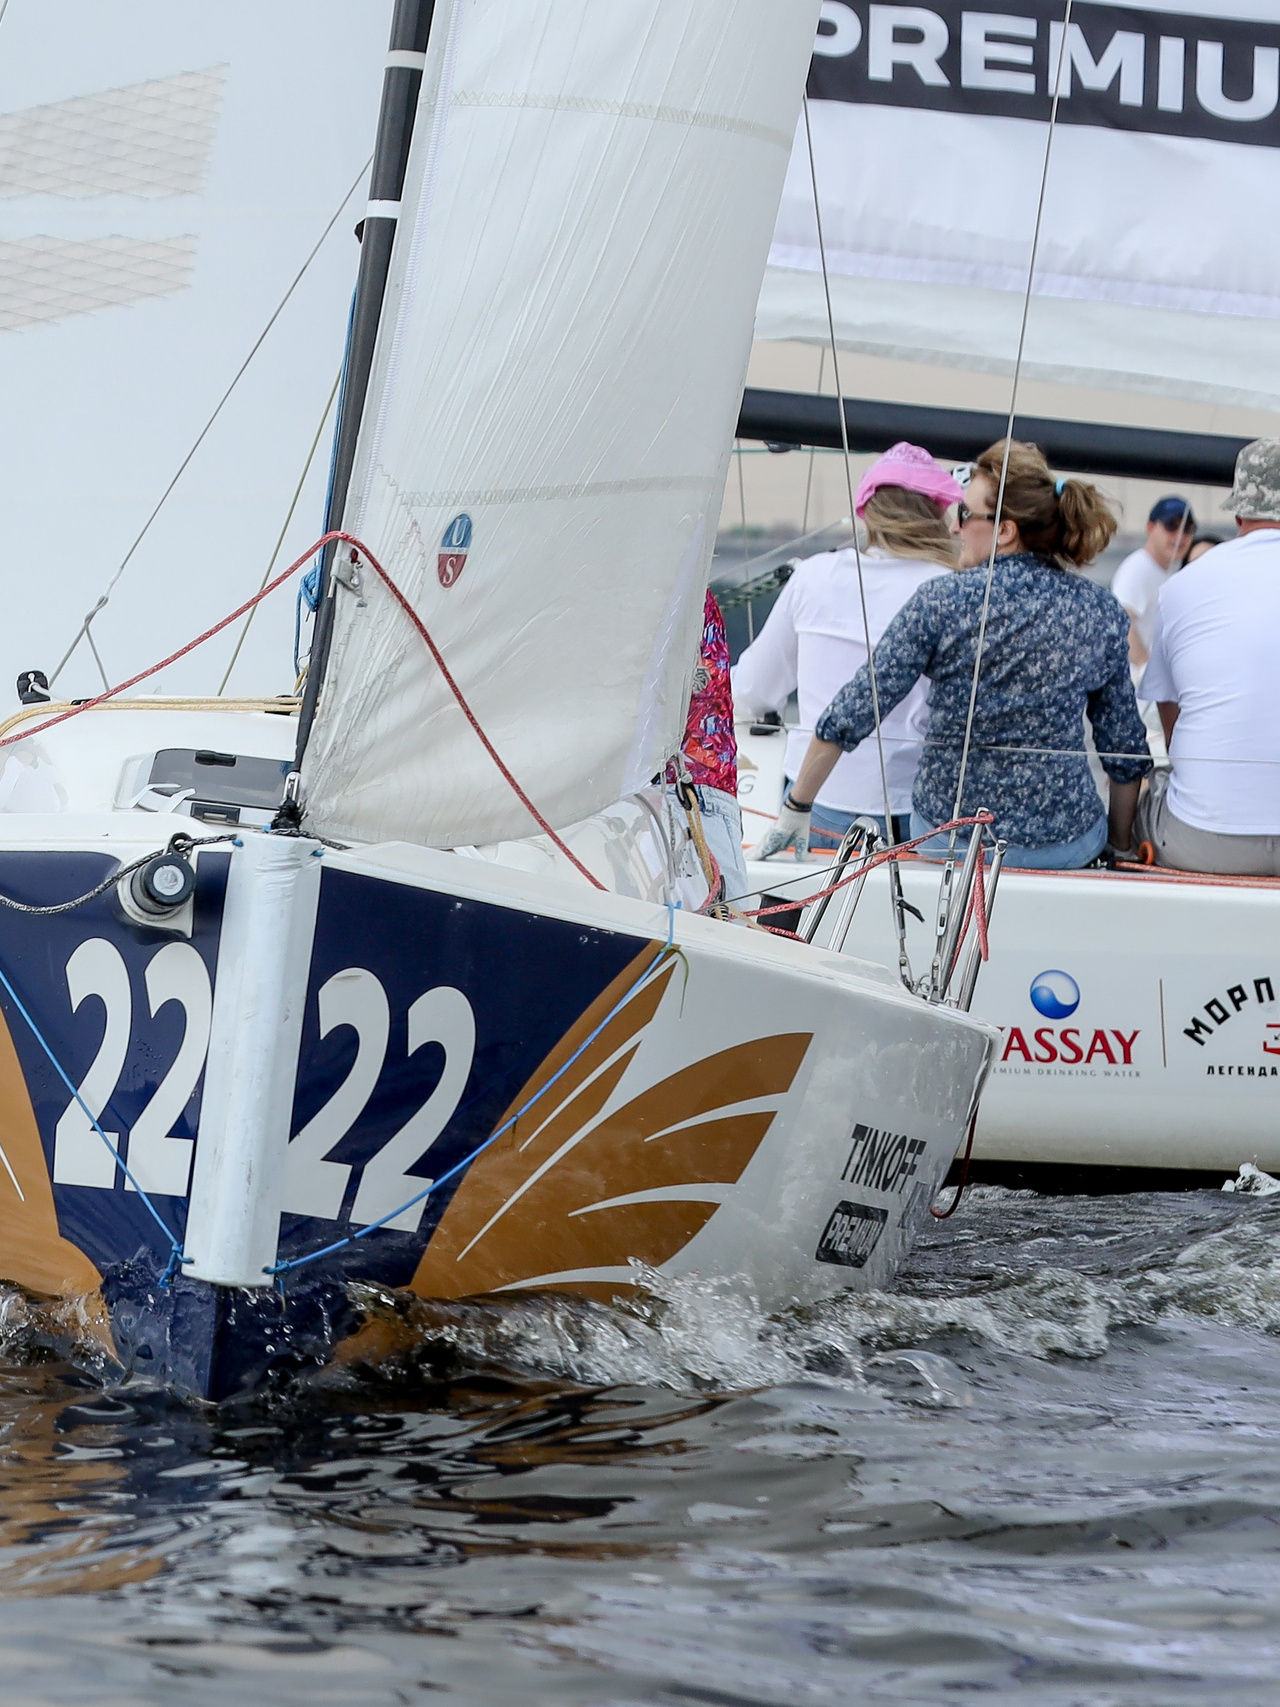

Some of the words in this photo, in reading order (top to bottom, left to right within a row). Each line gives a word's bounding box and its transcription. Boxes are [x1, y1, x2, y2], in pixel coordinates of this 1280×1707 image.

[53, 937, 213, 1197] 22
[996, 1026, 1141, 1065] ASSAY
[1037, 1068, 1097, 1077] DRINKING
[1103, 1070, 1141, 1078] WATER
[281, 966, 476, 1233] 22
[840, 1123, 927, 1194] TINKOFF
